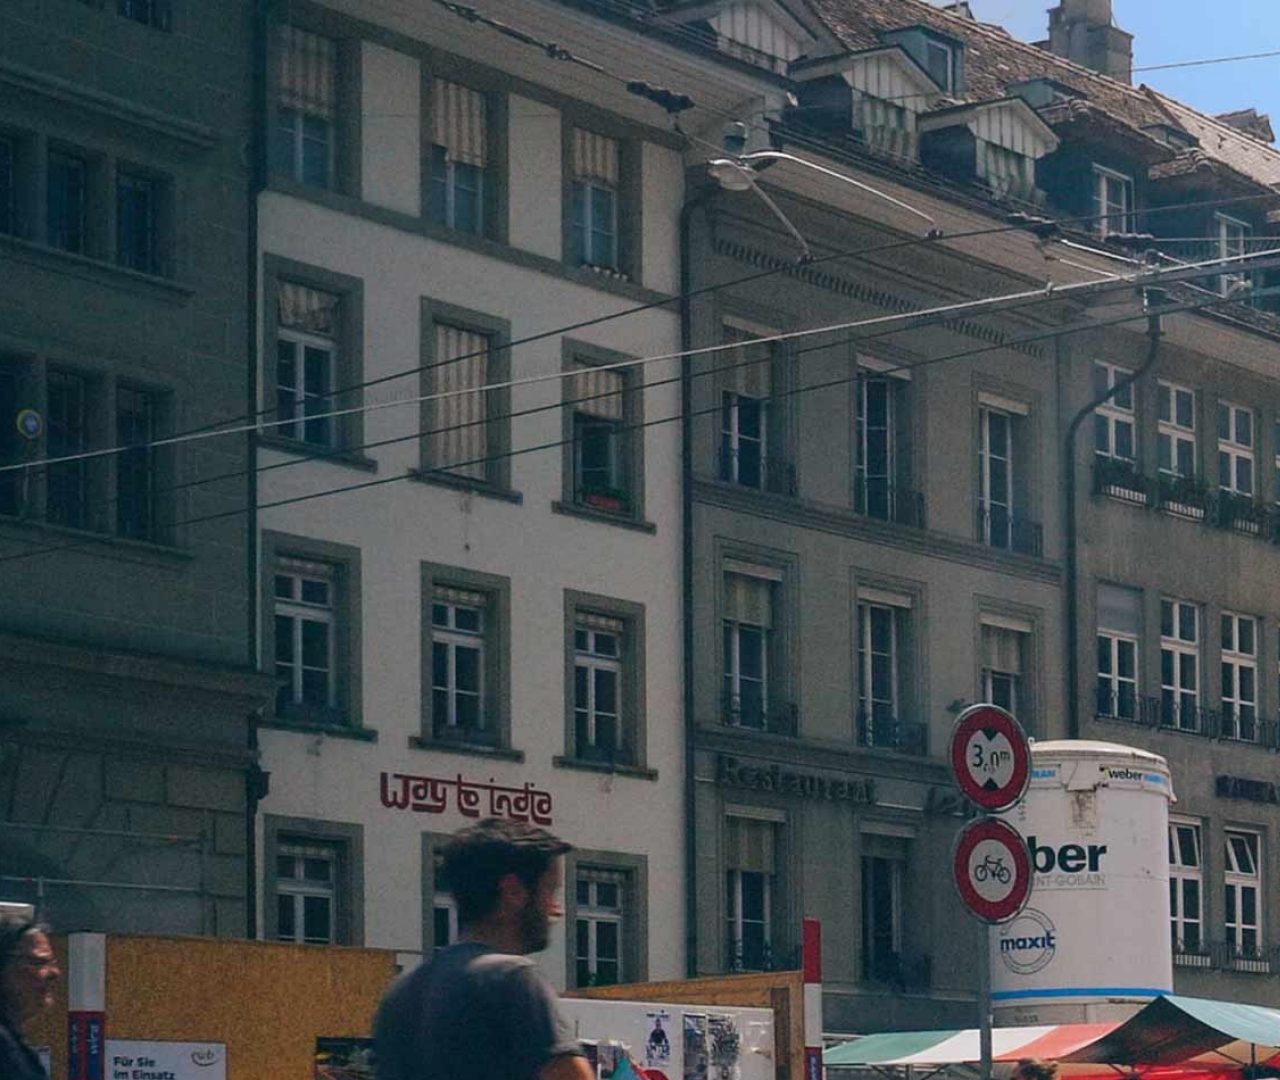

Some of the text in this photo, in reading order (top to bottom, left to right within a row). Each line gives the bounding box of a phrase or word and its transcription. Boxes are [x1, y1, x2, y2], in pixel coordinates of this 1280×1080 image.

[380, 771, 447, 814] Way
[456, 773, 480, 818] to
[1027, 834, 1107, 874] ber
[1000, 931, 1056, 951] maxit
[113, 1055, 156, 1067] Für Sie
[132, 1070, 176, 1080] Einsatz
